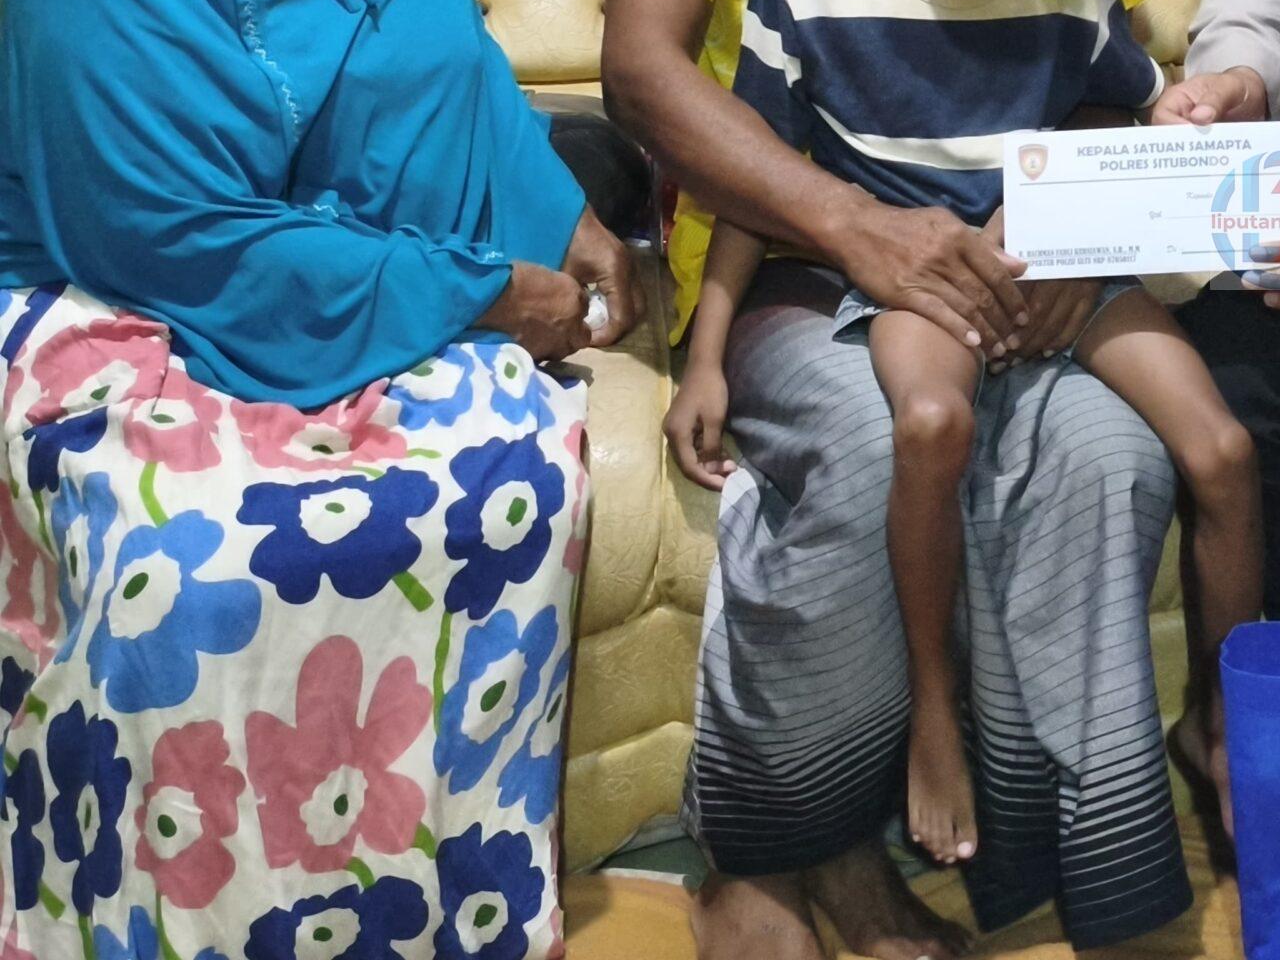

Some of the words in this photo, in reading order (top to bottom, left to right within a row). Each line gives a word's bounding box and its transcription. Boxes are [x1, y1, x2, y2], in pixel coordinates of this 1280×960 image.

[1076, 144, 1130, 157] KEPALA
[1133, 141, 1185, 155] SATUAN
[1189, 138, 1252, 152] SAMAPTA
[1099, 158, 1149, 171] POLRES
[1153, 155, 1230, 169] SITUBONDO
